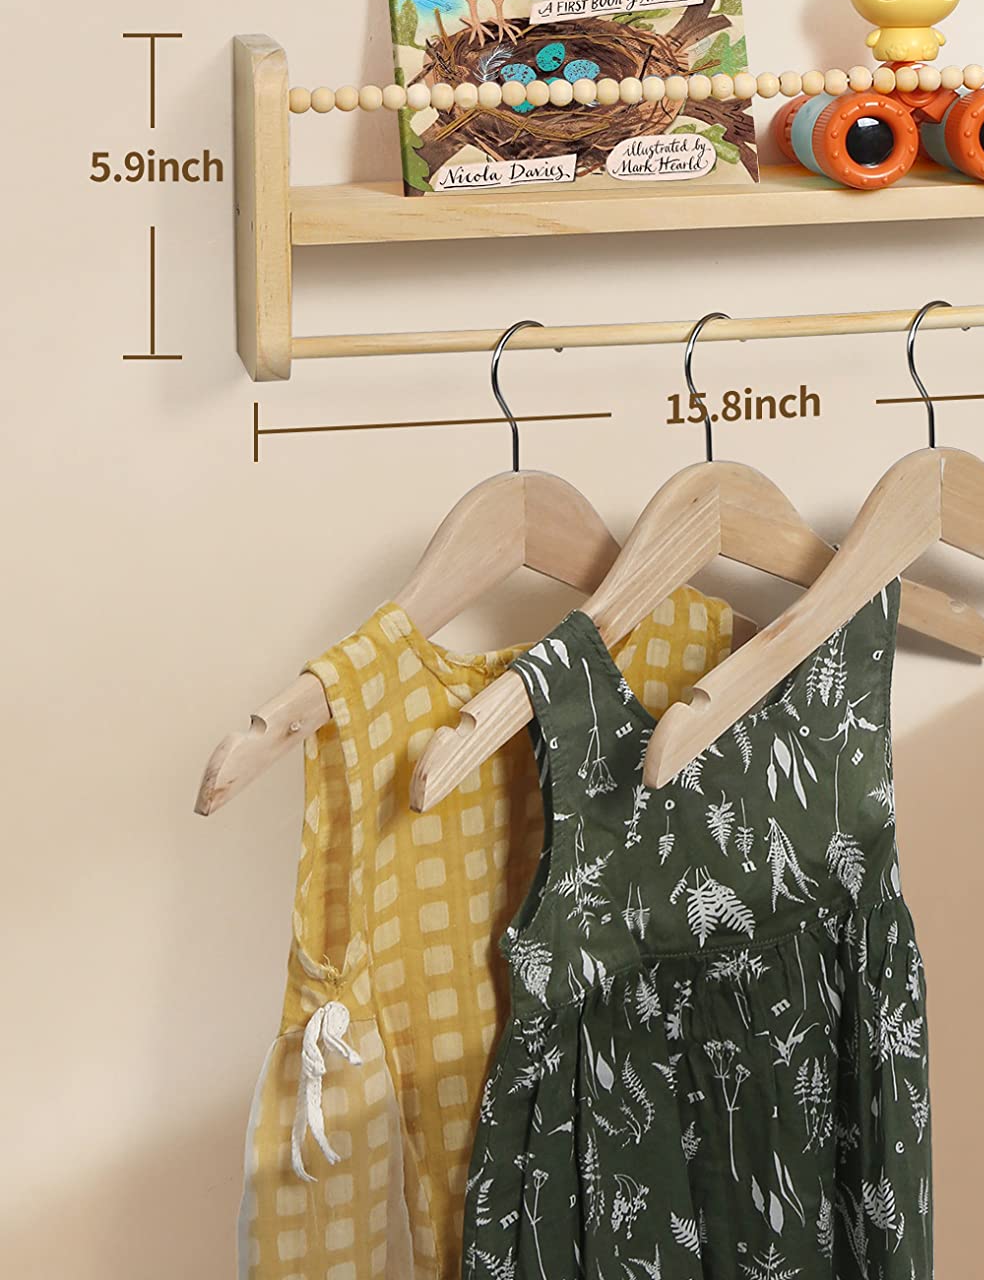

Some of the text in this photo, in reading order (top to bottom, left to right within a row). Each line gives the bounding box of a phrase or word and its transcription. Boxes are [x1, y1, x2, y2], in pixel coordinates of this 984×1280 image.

[538, 2, 553, 15] A
[556, 0, 588, 13] FIRST
[440, 164, 502, 186] Nicola
[612, 159, 657, 175] Mark
